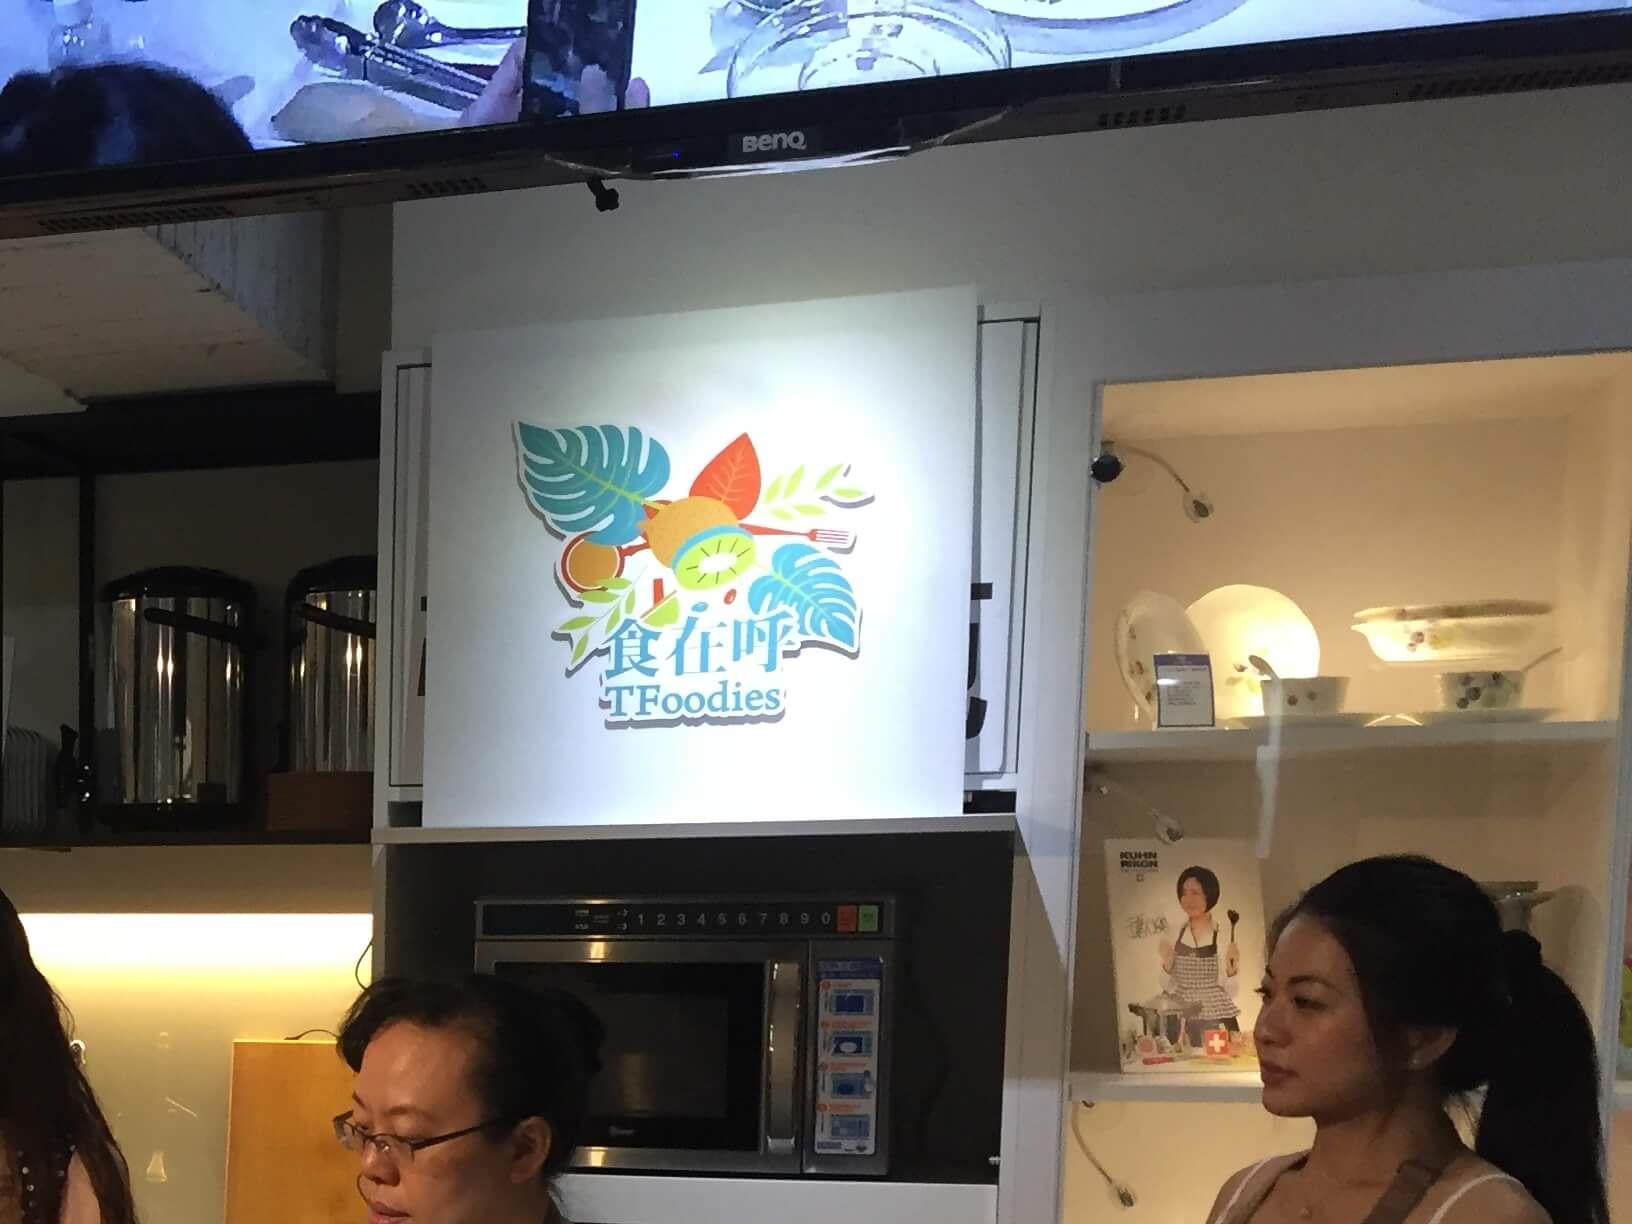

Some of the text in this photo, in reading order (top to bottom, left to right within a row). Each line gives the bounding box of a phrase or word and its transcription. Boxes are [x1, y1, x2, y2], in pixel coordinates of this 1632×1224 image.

[742, 130, 808, 153] BenQ
[601, 611, 795, 680] 食在呼
[605, 680, 781, 717] TFoodies
